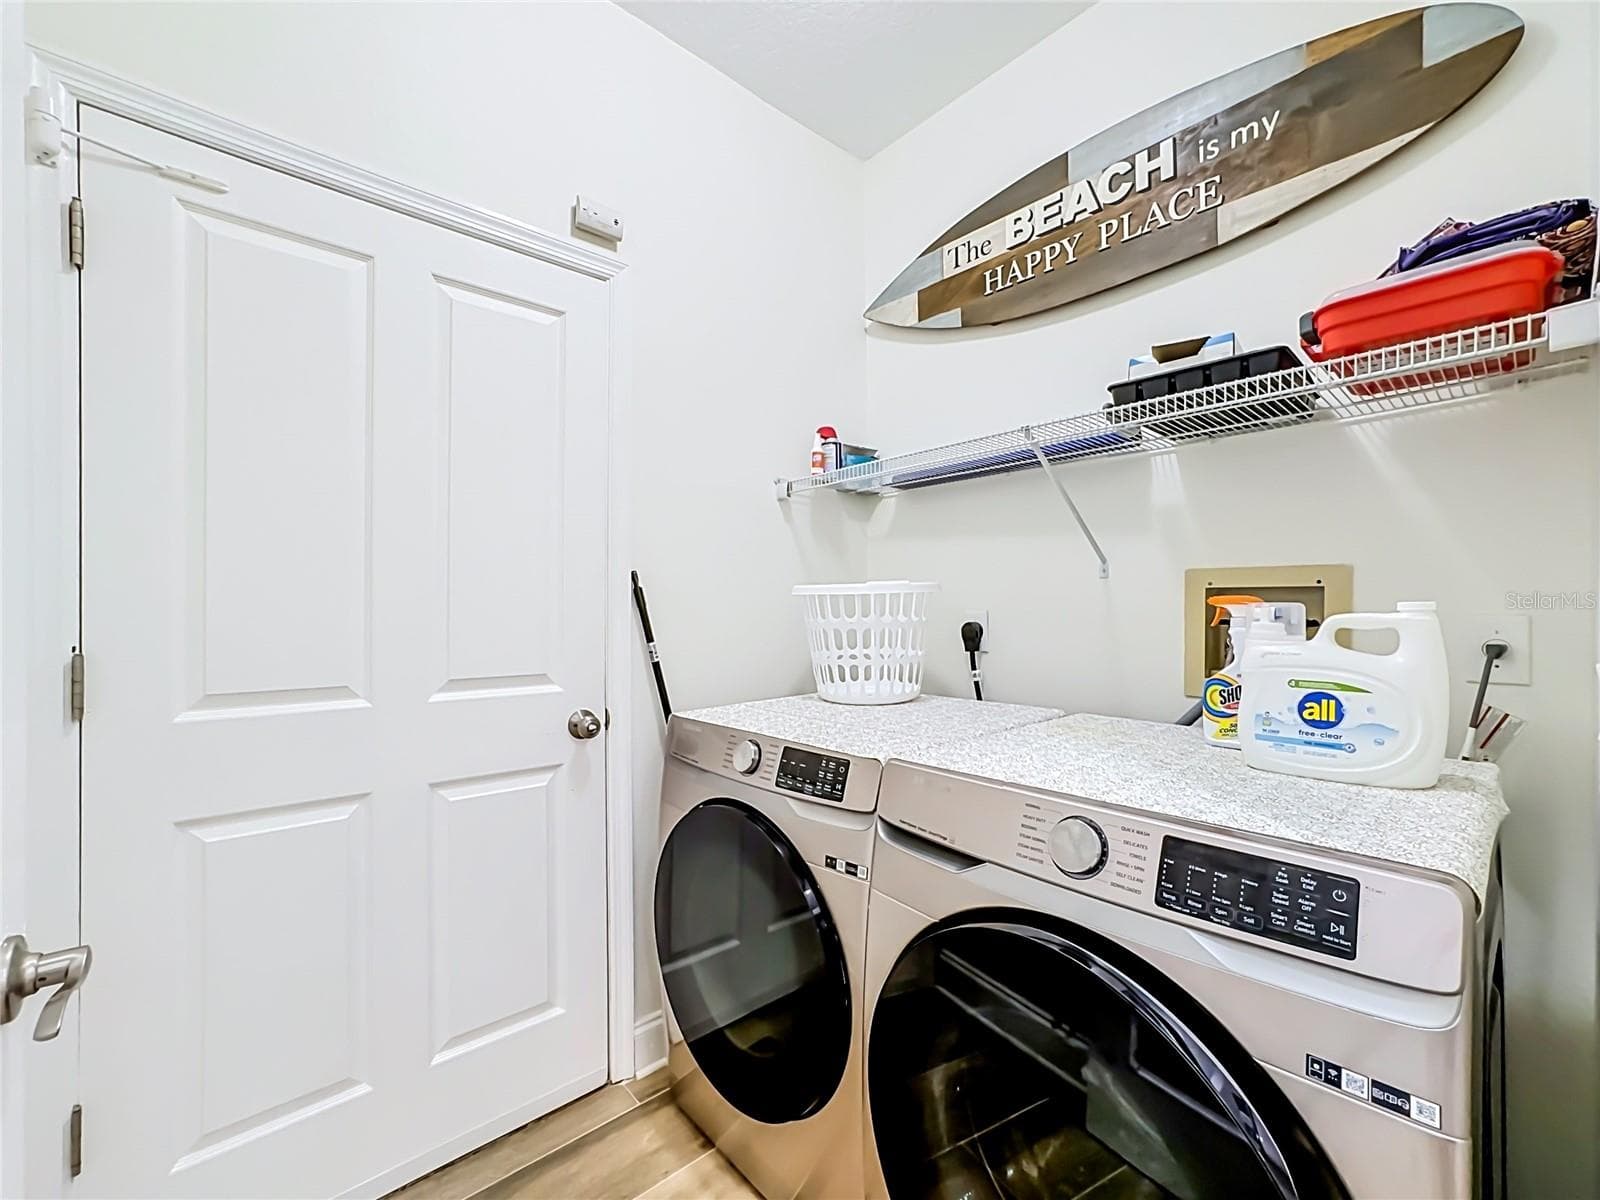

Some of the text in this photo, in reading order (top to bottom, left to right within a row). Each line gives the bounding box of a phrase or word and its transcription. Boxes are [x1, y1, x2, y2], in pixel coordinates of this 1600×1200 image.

[947, 109, 1281, 270] The BEACH is my
[983, 174, 1226, 297] HAPPY PLACE
[1298, 729, 1344, 741] free clear
[1301, 698, 1337, 722] all
